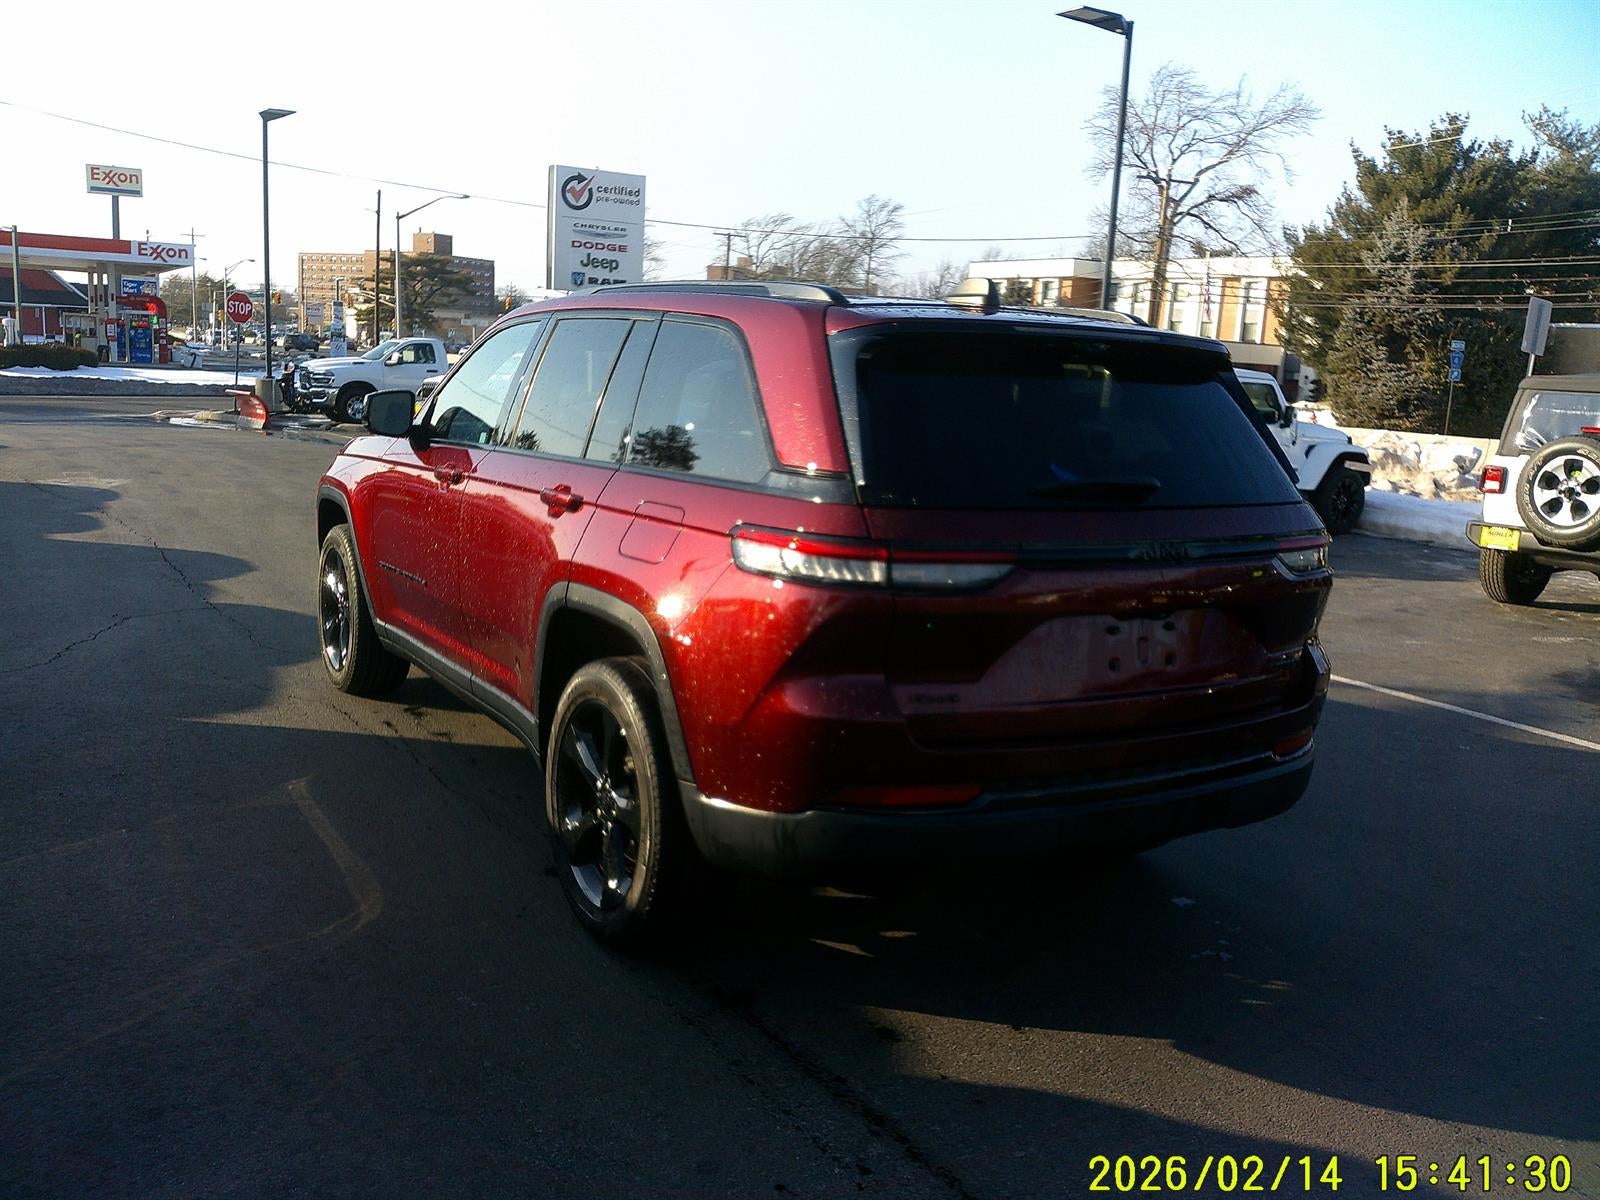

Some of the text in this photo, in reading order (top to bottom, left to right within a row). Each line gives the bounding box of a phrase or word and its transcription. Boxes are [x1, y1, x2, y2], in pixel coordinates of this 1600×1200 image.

[90, 166, 139, 187] Exxon
[597, 184, 641, 198] certified
[596, 196, 640, 206] pre-owned
[573, 222, 627, 232] CHRYSLER
[137, 242, 188, 263] Exxon
[571, 240, 628, 252] DODGE
[580, 253, 619, 272] Jeep
[228, 300, 252, 315] STOP
